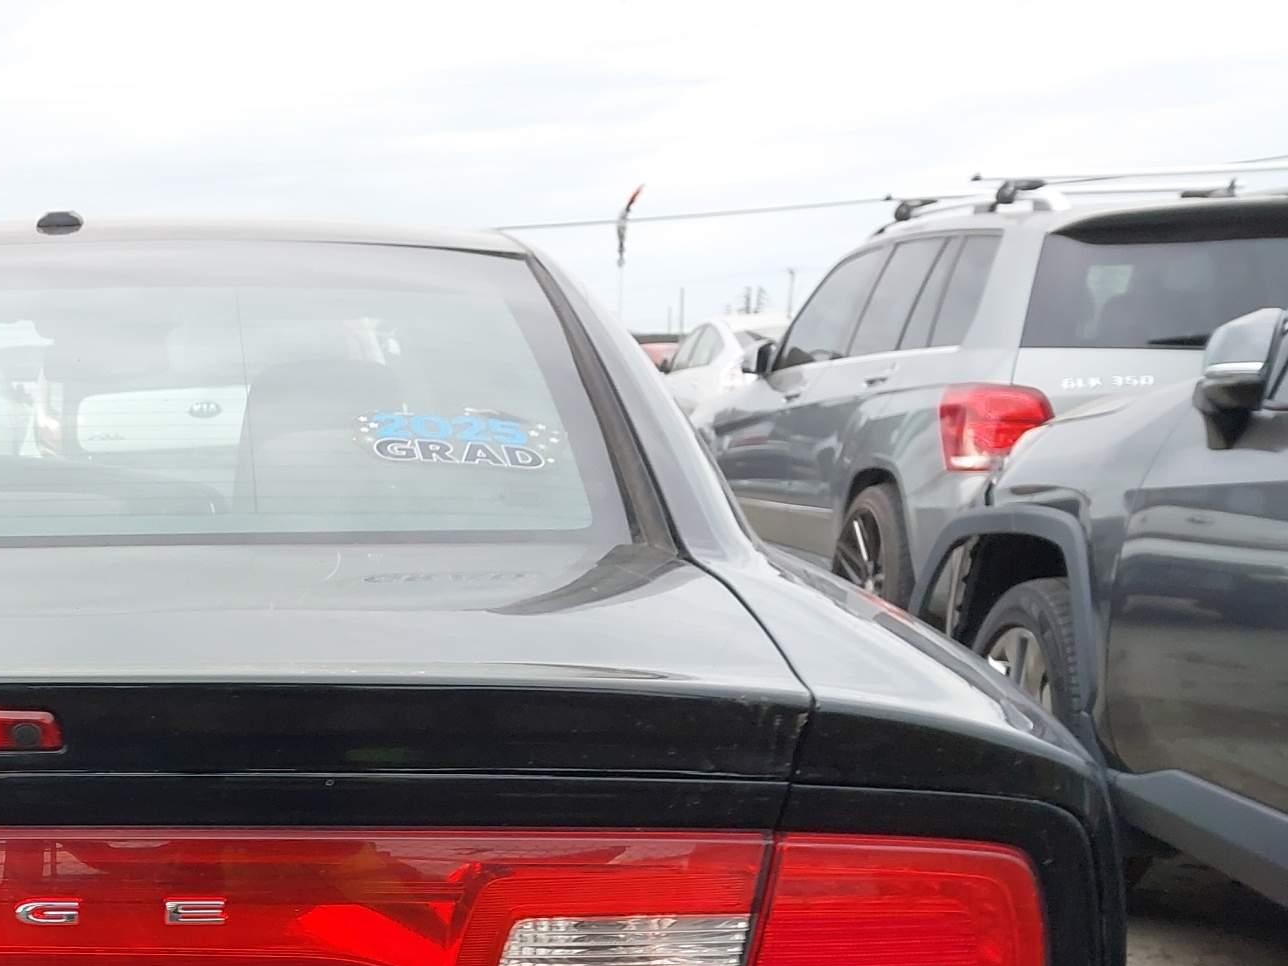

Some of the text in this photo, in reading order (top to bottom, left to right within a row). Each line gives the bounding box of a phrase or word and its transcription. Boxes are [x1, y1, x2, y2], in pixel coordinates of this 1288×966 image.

[1111, 374, 1155, 386] 350
[373, 412, 528, 446] 2025
[373, 437, 545, 469] GRAD
